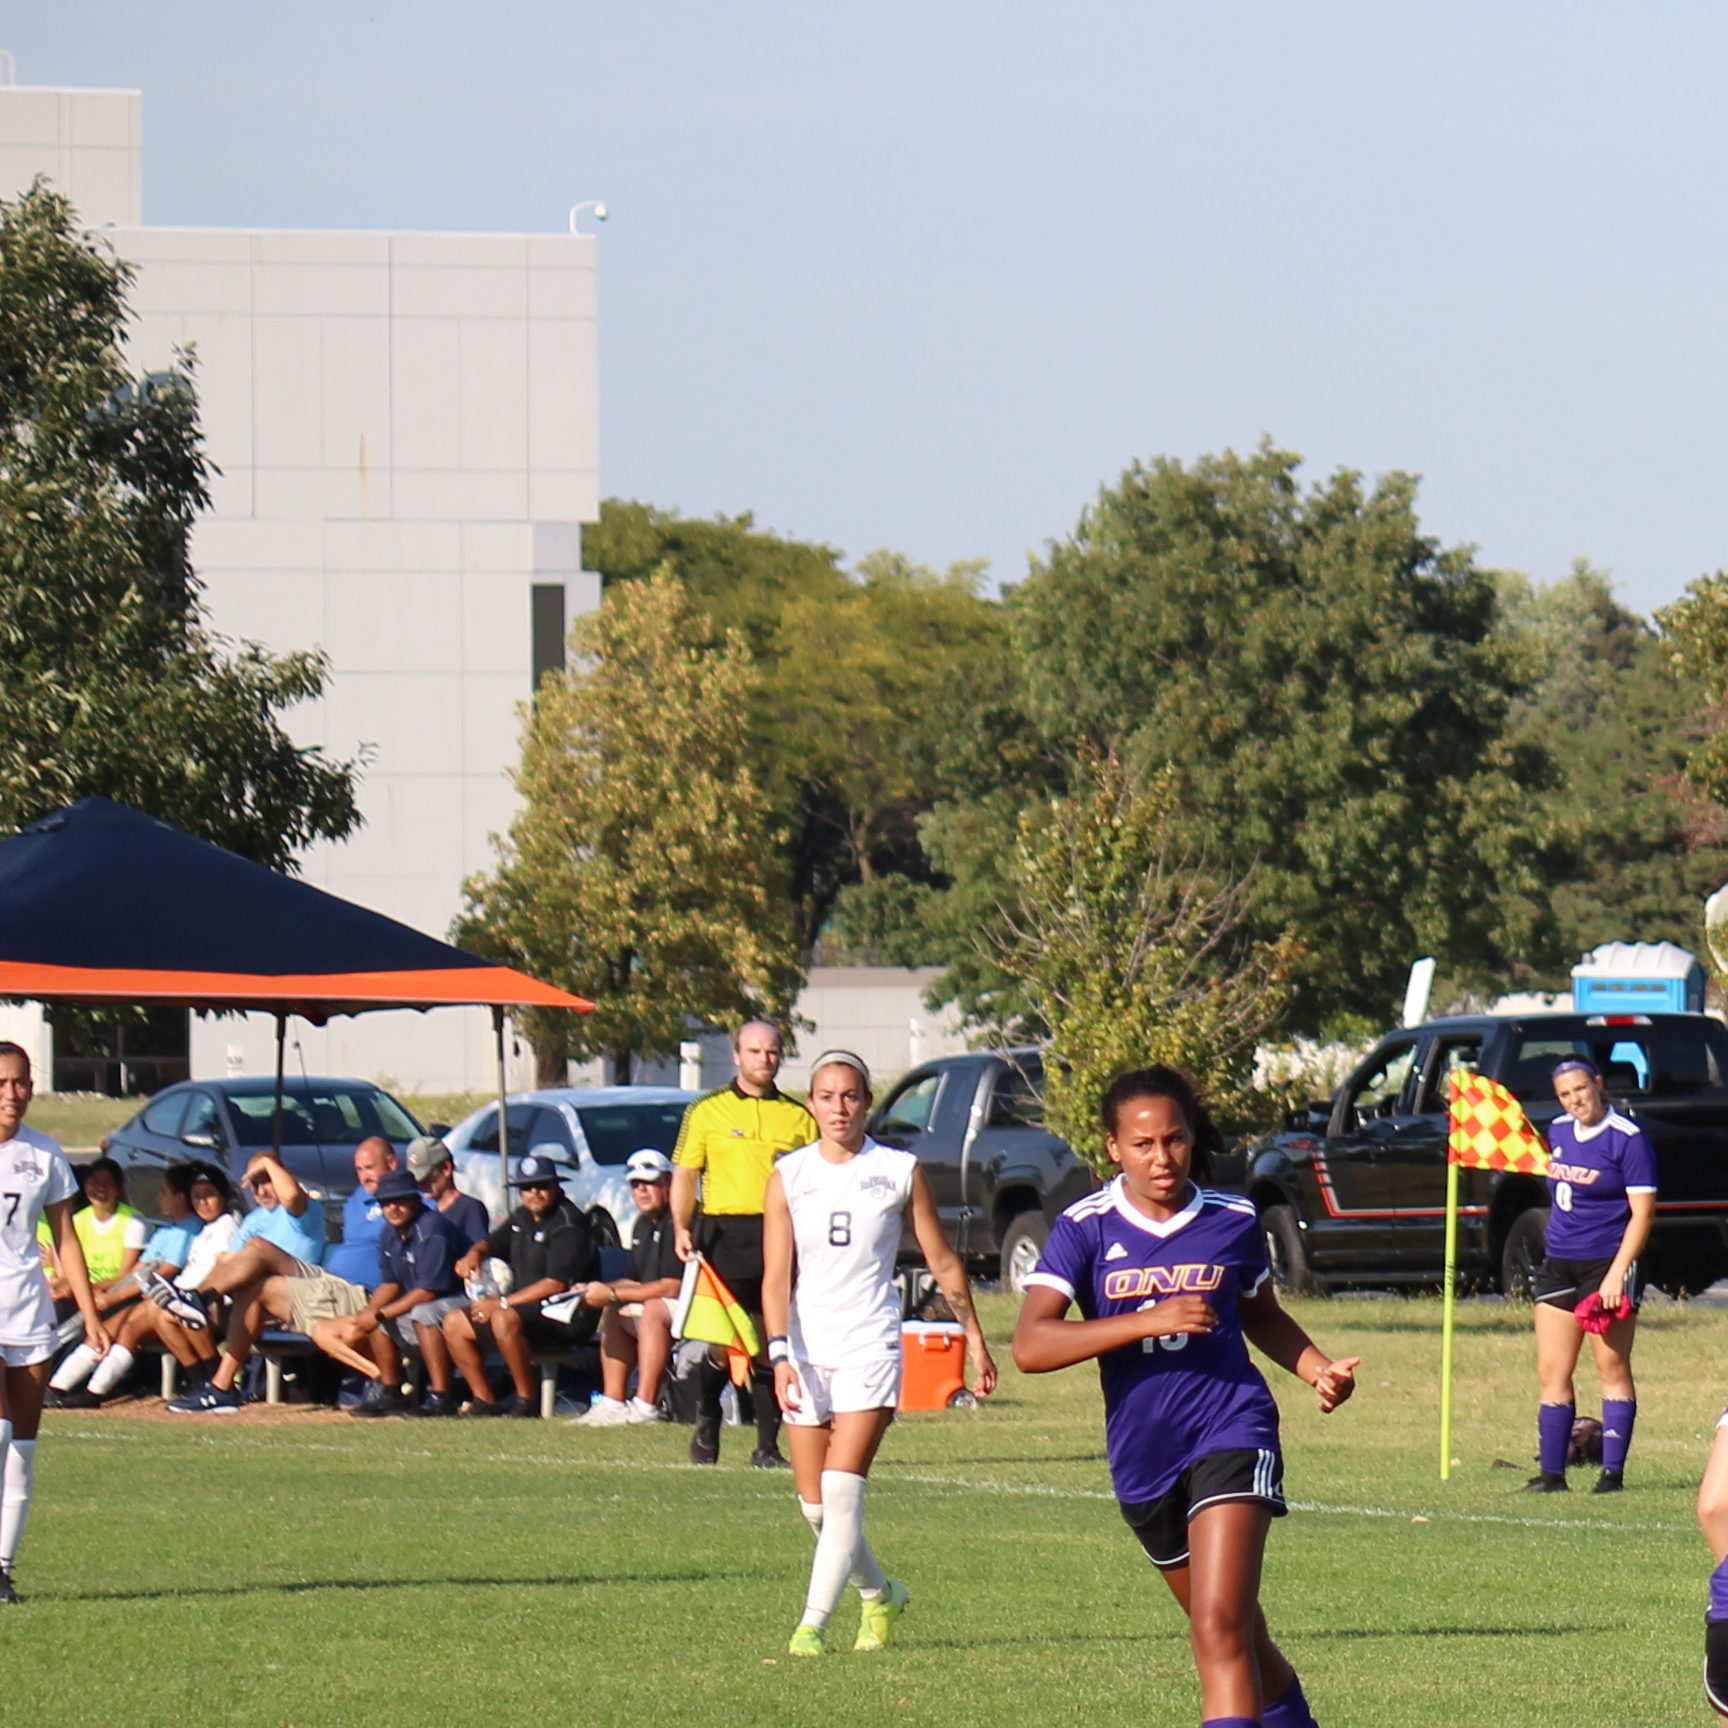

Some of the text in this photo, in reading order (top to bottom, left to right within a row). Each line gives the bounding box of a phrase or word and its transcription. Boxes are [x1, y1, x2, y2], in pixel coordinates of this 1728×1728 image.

[3, 1192, 21, 1227] 7
[828, 1210, 852, 1247] 8
[1104, 1263, 1226, 1299] ONU
